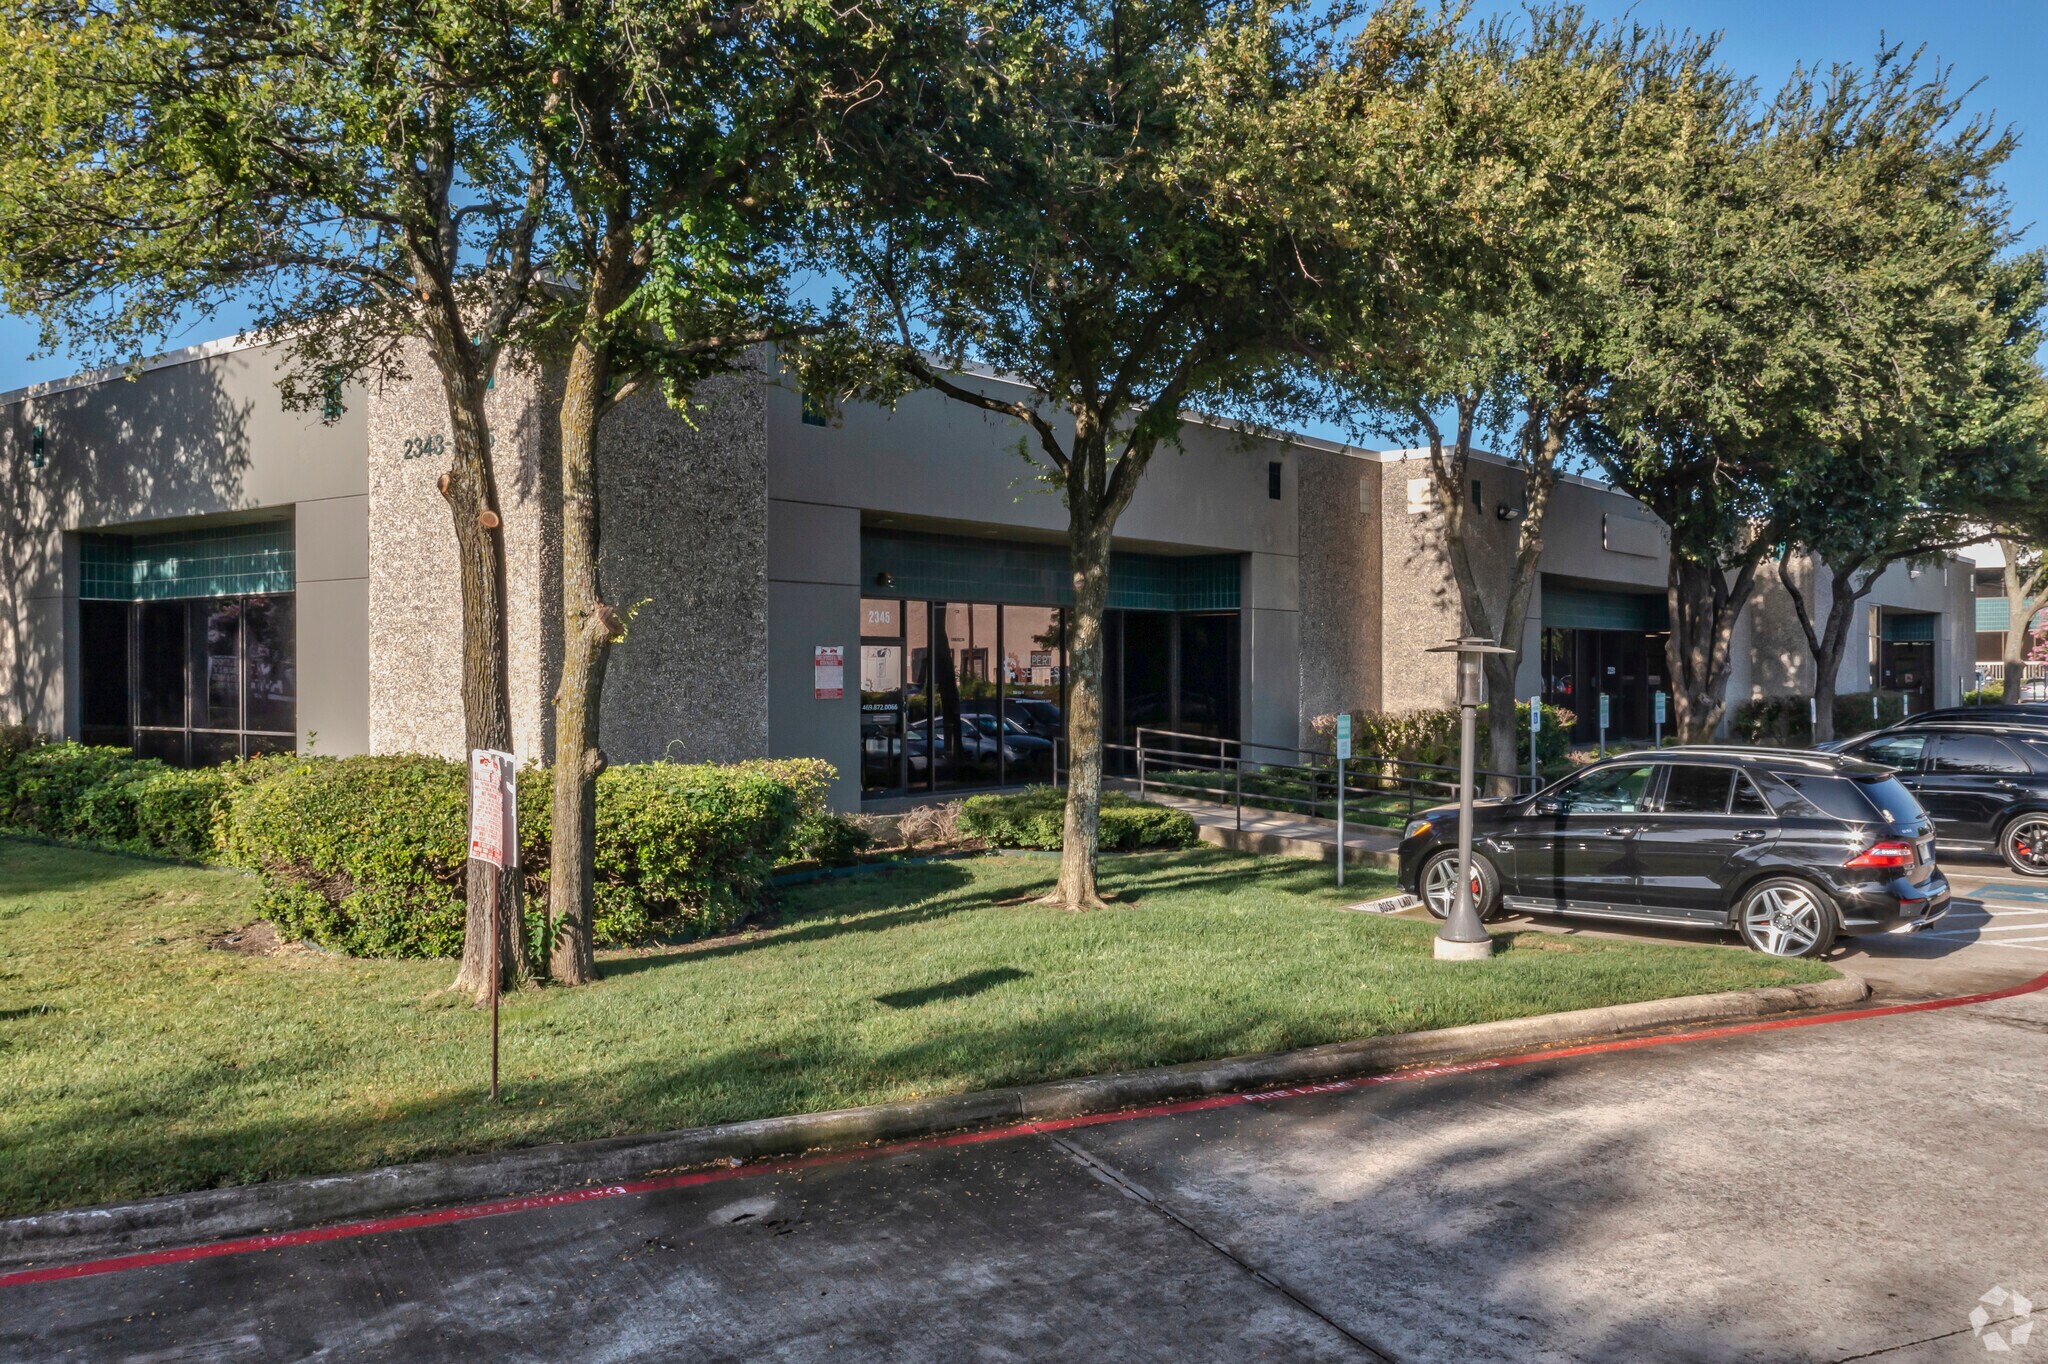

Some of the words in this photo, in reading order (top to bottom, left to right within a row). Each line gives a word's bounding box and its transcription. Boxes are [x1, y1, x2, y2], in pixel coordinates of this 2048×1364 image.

[868, 610, 891, 624] 2345
[1377, 900, 1396, 913] BOSS
[1397, 895, 1415, 909] LADY
[1242, 1089, 1293, 1101] FIRE
